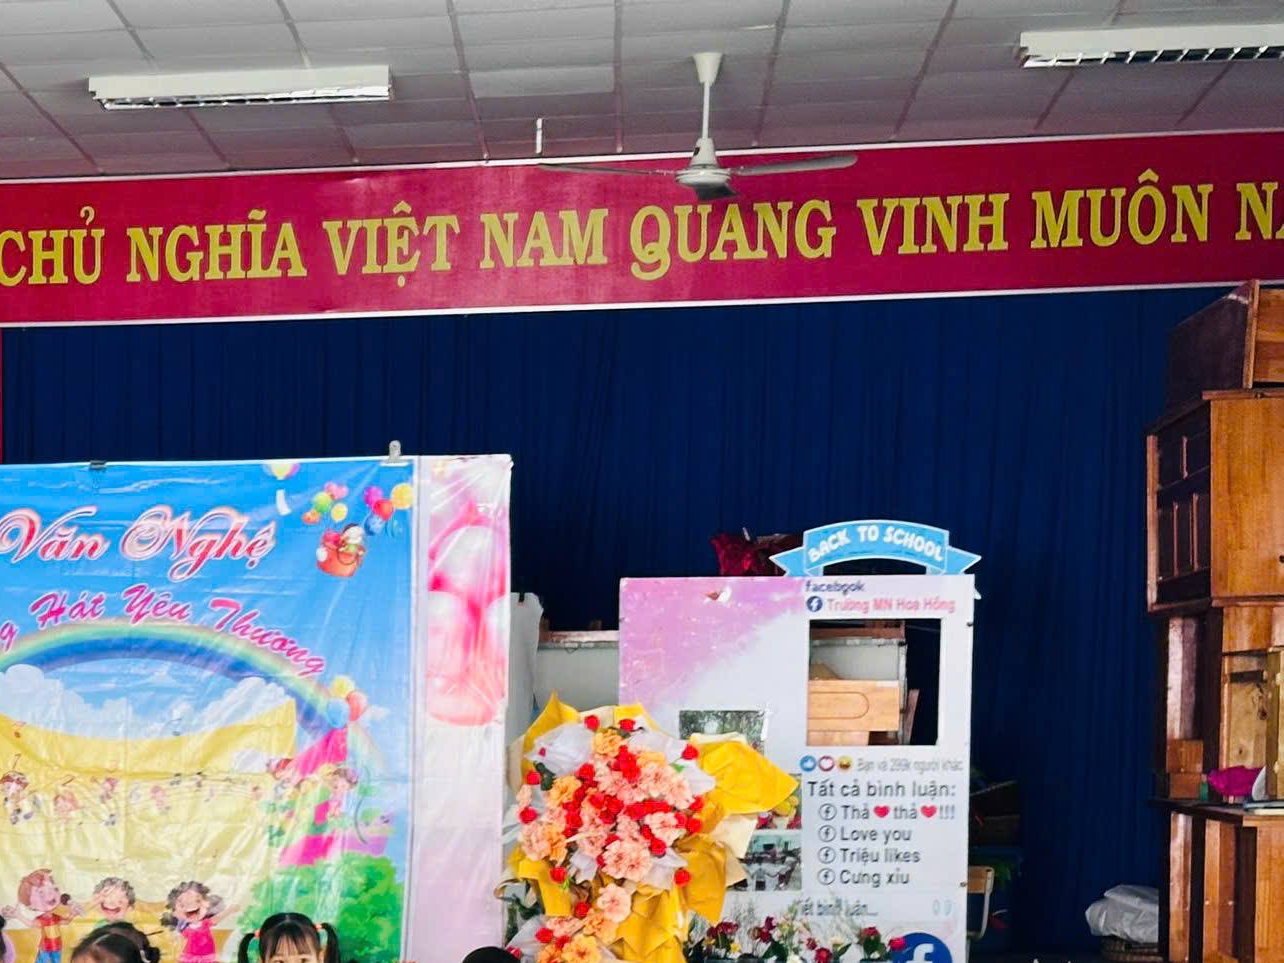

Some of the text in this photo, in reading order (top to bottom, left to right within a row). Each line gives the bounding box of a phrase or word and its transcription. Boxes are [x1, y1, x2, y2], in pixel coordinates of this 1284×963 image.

[125, 209, 308, 283] NGHĨA
[321, 200, 461, 288] VIỆT
[478, 208, 609, 270] NAM
[628, 199, 837, 282] QUANG
[856, 192, 1010, 256] VINH
[1029, 167, 1214, 249] MUÔN
[1234, 181, 1284, 241] N
[118, 505, 277, 583] Nghệ
[809, 525, 945, 562] BACK TO SCHOOL
[28, 592, 105, 628] Hát
[122, 583, 194, 625] Yêu
[210, 597, 326, 677] Thương
[807, 777, 956, 801] Tất cả bình luận:
[840, 826, 914, 845] Love you
[840, 848, 922, 866] Triệu likes
